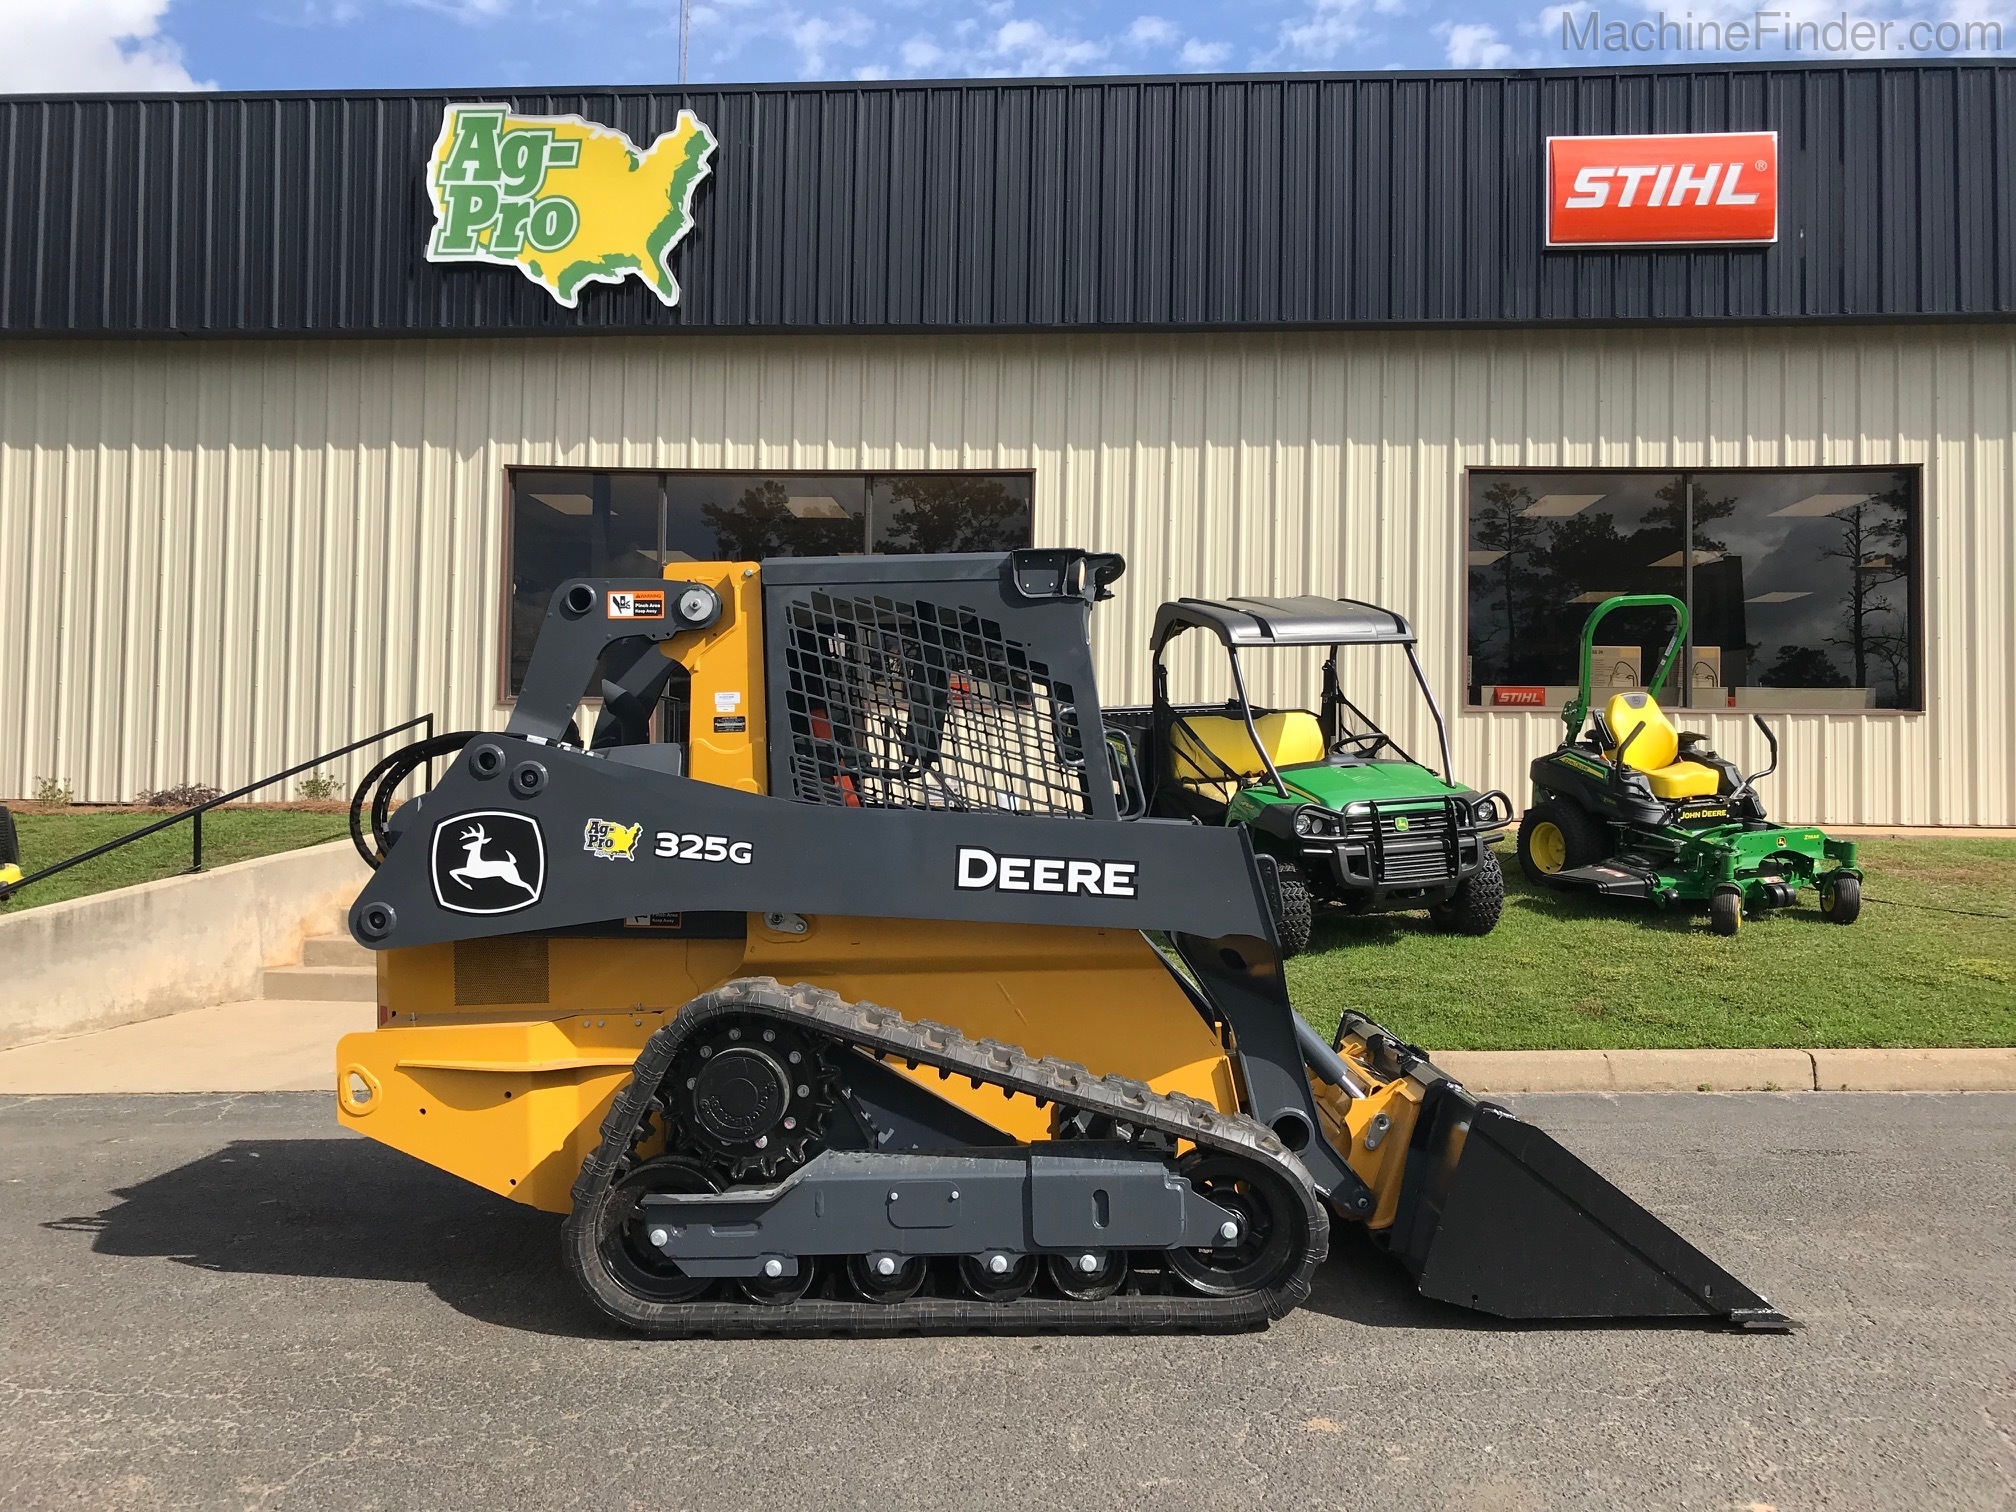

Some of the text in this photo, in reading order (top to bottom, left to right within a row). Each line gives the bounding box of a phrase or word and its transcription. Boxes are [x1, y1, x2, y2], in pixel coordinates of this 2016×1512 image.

[437, 111, 581, 199] Ag-
[1564, 163, 1760, 209] STIHL
[435, 184, 579, 254] Pro
[1499, 692, 1541, 703] STIHL
[588, 821, 615, 837] Ag-
[1680, 809, 1727, 820] JOHN DEERE
[587, 835, 614, 848] Pro
[655, 832, 753, 864] 325G
[958, 848, 1136, 896] DEERE
